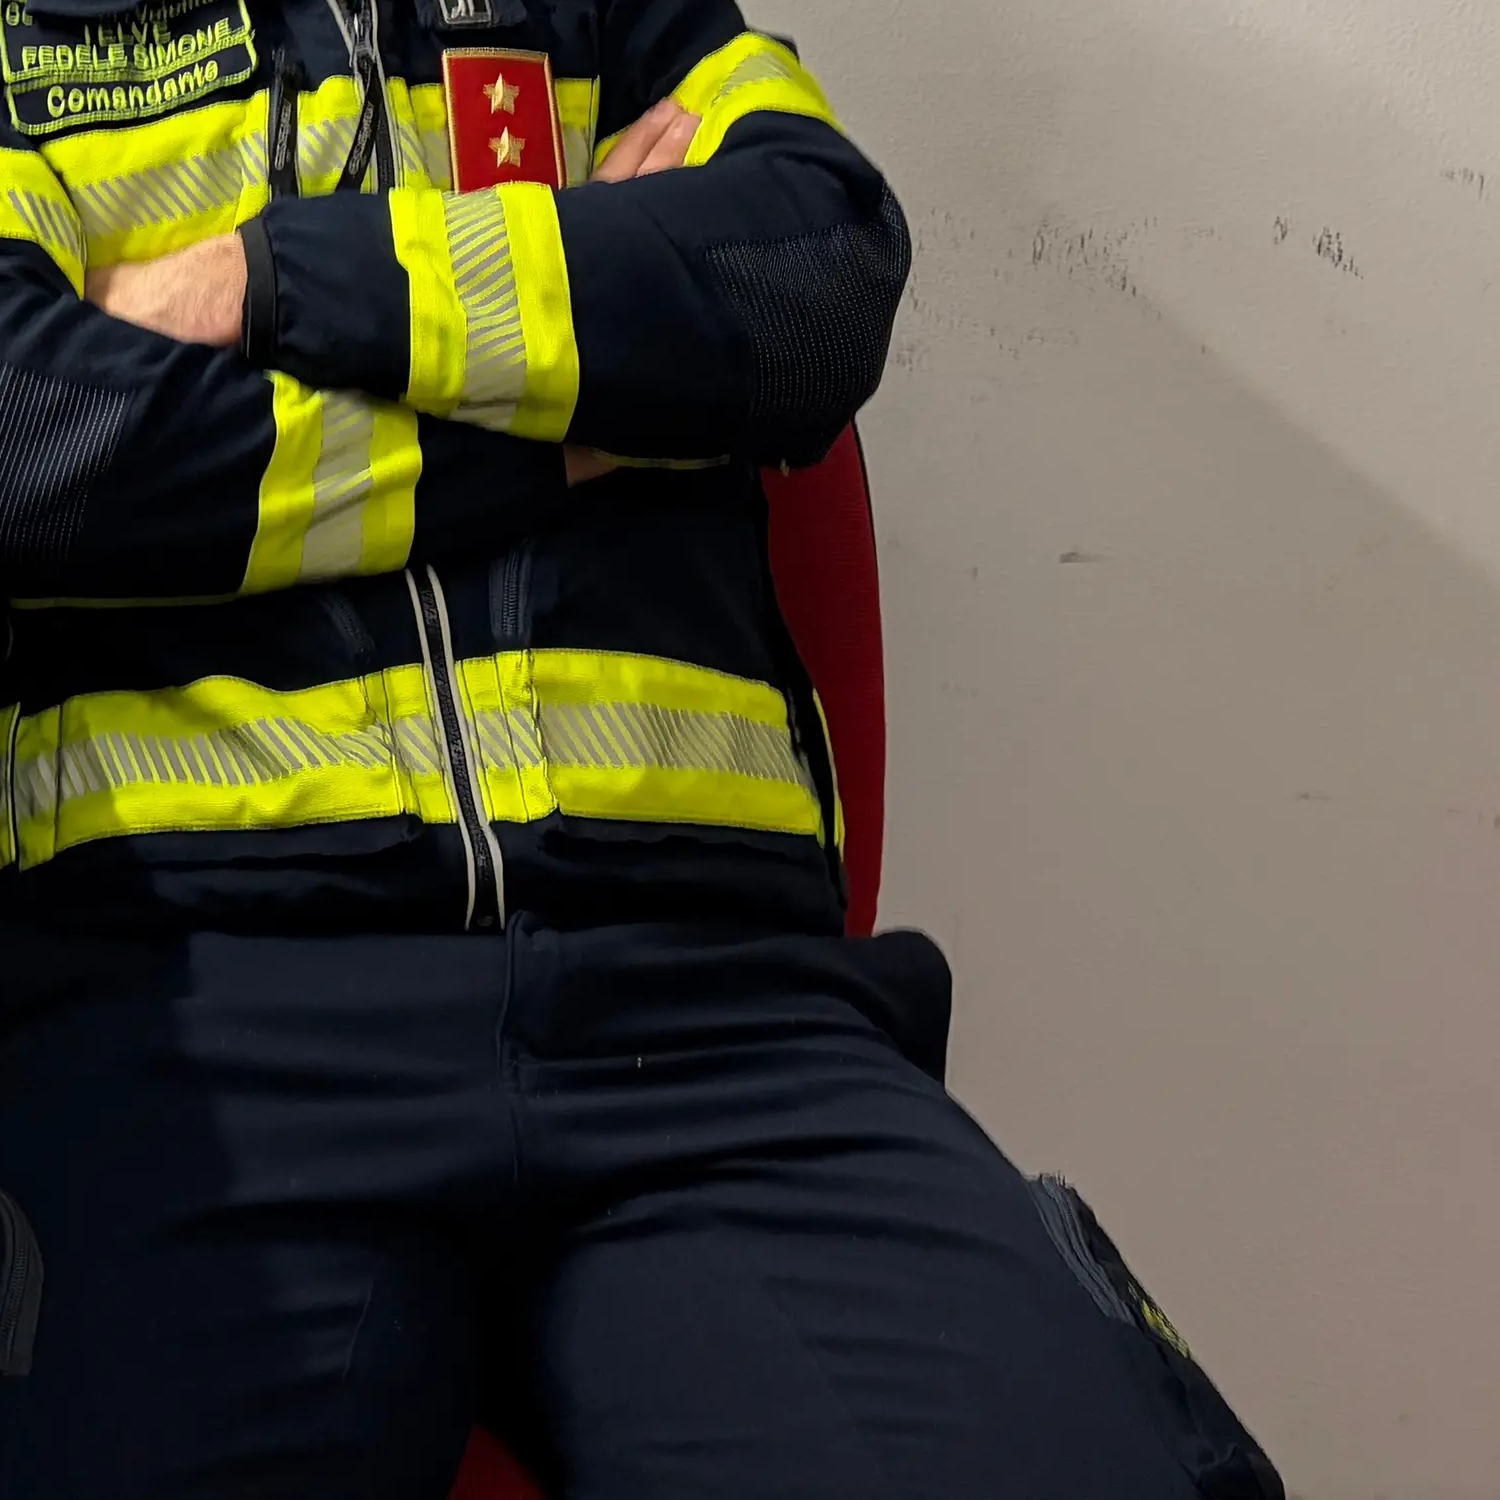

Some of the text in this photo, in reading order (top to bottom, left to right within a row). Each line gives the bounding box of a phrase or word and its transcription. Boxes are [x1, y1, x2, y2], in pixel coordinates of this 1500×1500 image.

[21, 17, 232, 72] FEDELE SIMONE
[47, 60, 219, 118] Comandante
